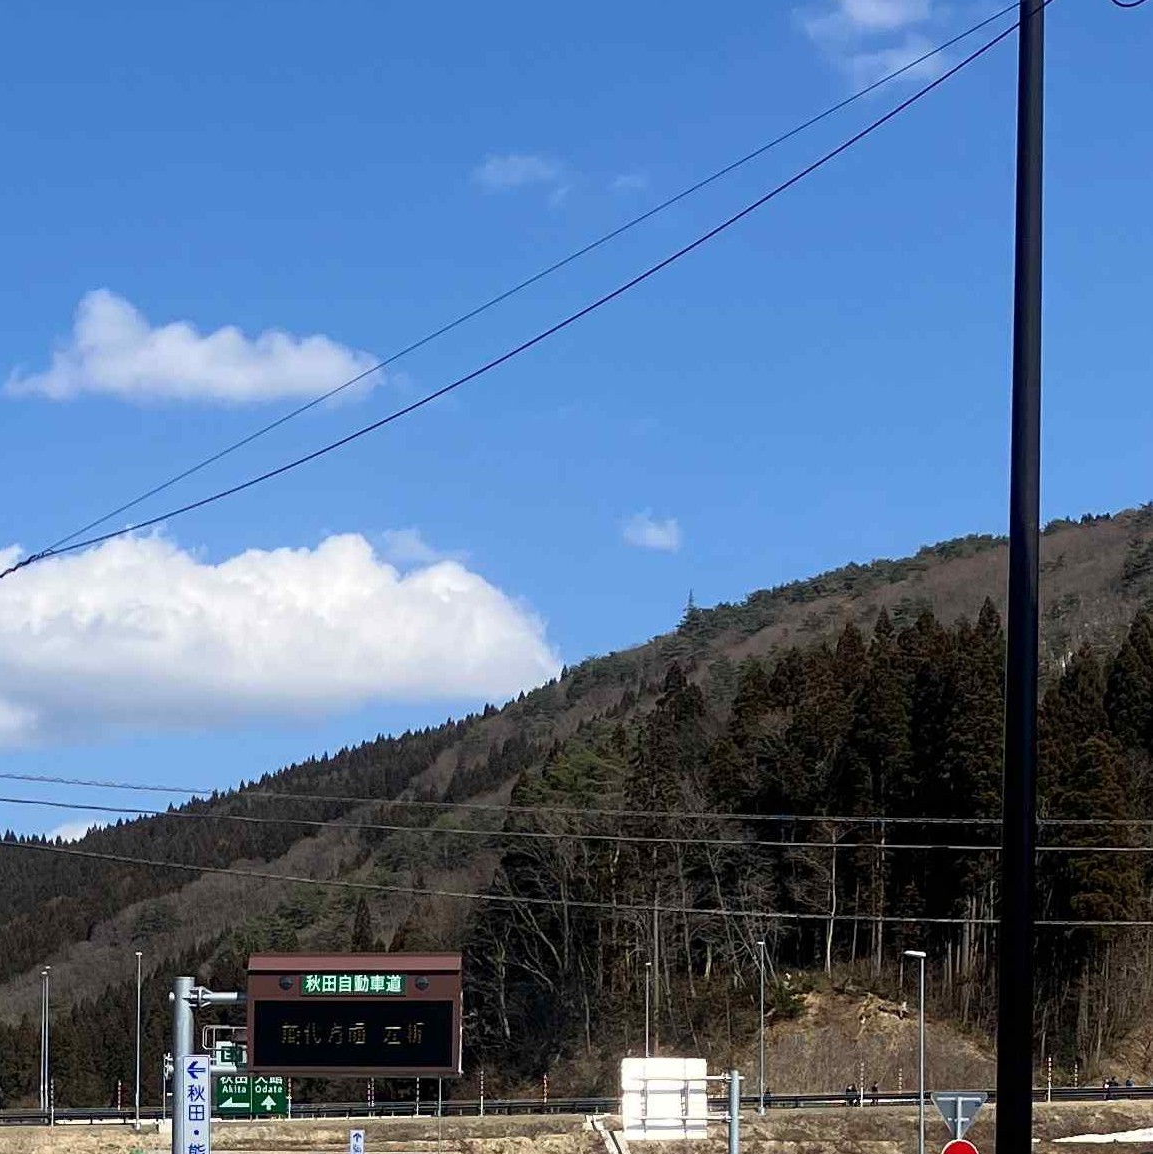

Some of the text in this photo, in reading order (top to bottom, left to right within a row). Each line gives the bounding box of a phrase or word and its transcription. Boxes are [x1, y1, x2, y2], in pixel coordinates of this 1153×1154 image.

[305, 974, 401, 993] 秋田自動車道
[222, 1084, 247, 1093] Akita
[255, 1084, 283, 1093] Odate
